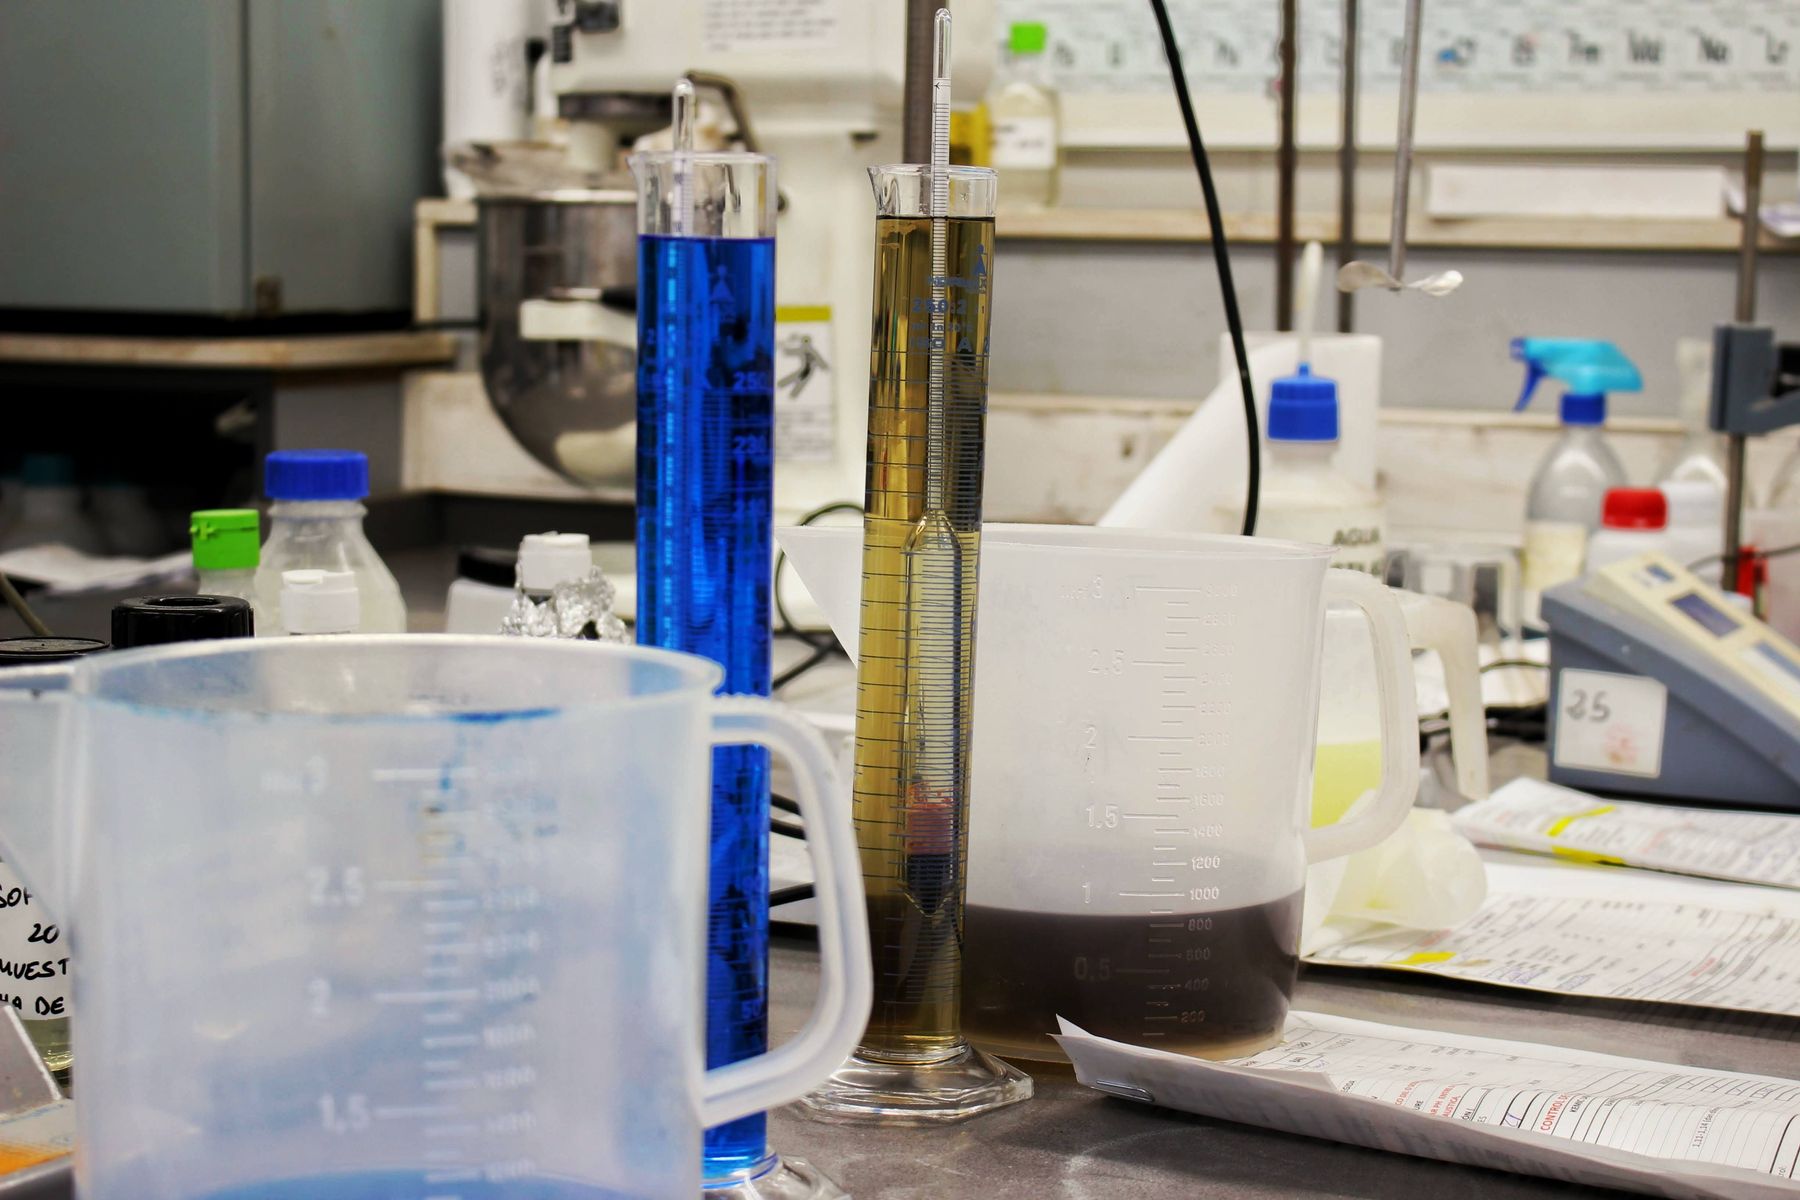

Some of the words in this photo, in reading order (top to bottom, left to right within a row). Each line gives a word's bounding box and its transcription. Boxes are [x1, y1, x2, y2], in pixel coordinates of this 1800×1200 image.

[1191, 855, 1221, 872] 1200
[1081, 880, 1092, 905] 1
[1189, 886, 1220, 902] 1000
[1188, 917, 1213, 931] 800
[1181, 1010, 1206, 1024] 200
